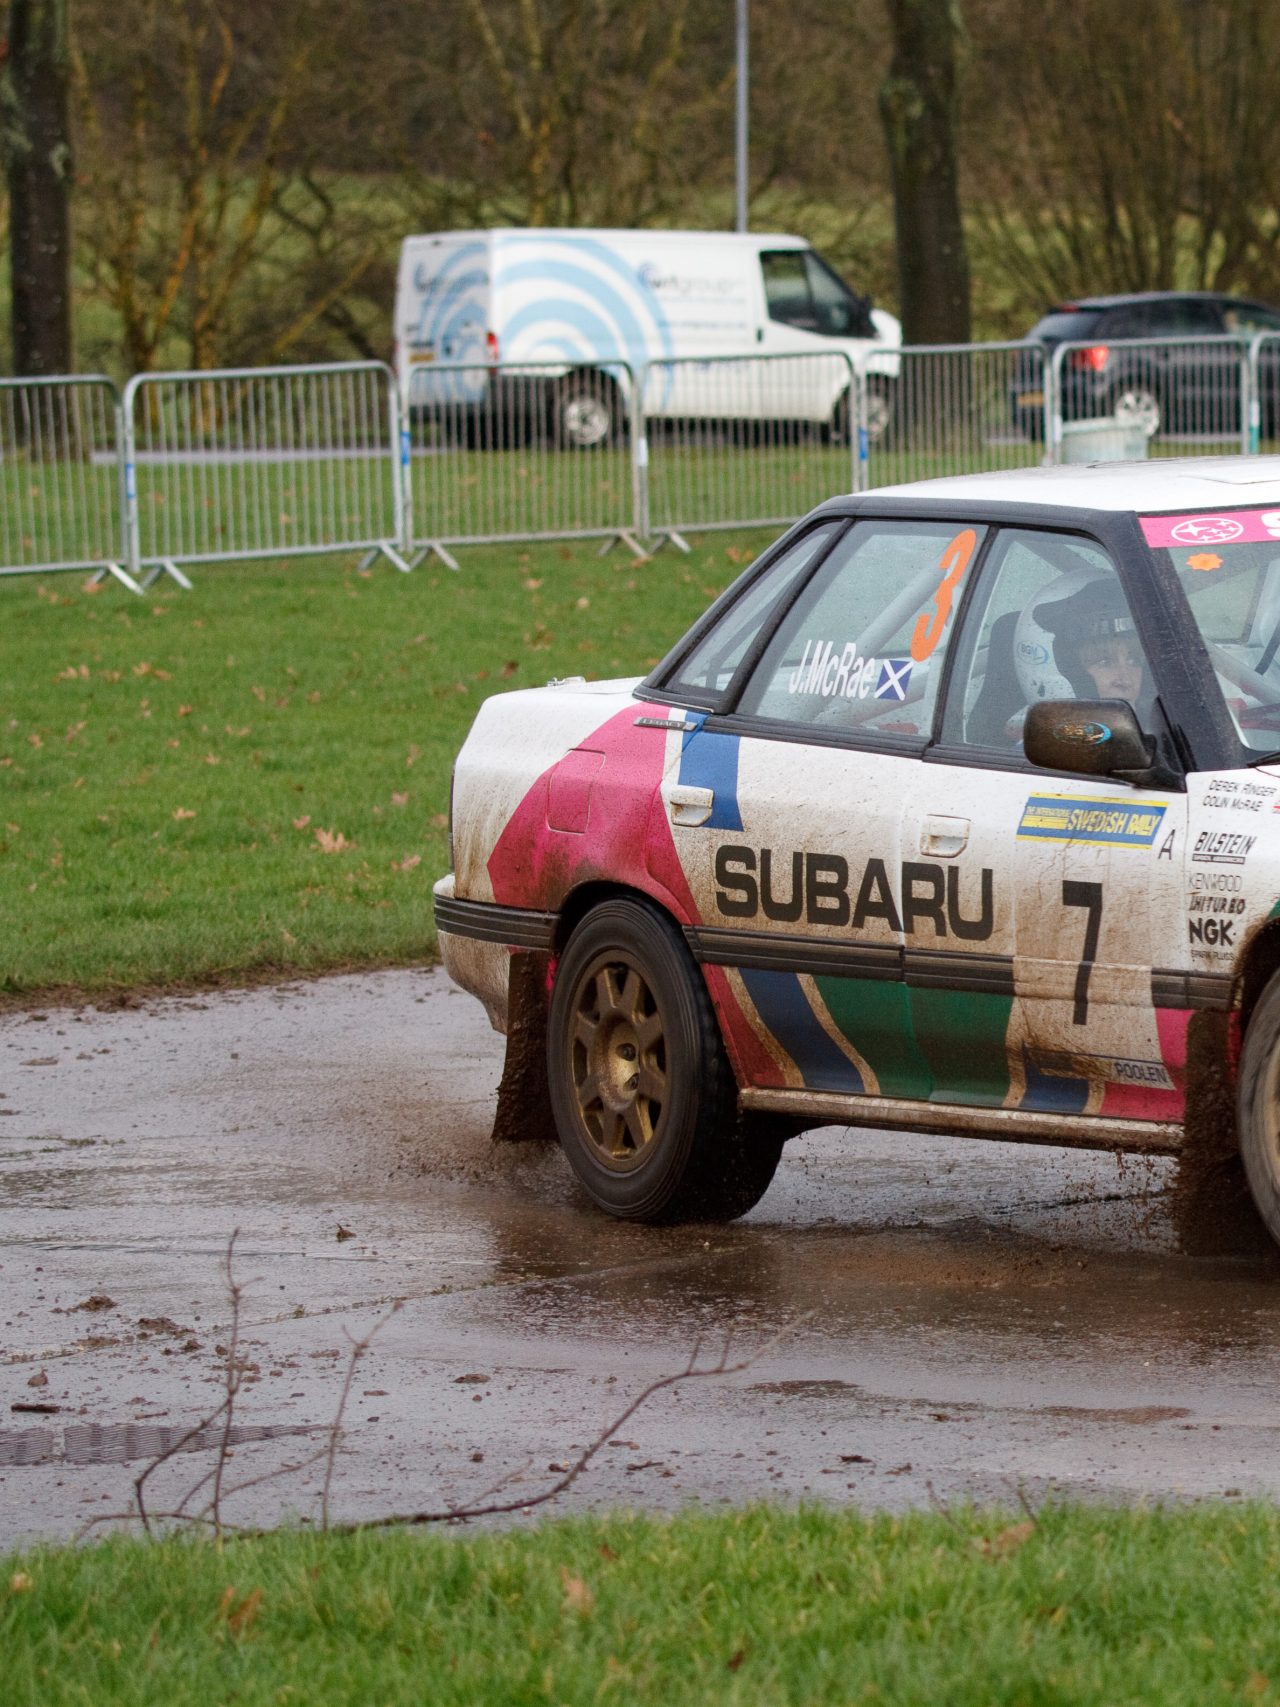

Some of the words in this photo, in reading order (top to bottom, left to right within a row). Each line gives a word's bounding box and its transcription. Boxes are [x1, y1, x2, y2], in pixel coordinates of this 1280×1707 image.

[910, 529, 976, 662] 3
[788, 640, 876, 699] J.McRae
[1202, 795, 1230, 808] COLIN
[1208, 779, 1240, 792] DEREK
[1157, 828, 1176, 860] A
[1194, 831, 1258, 855] BILSTEIN
[715, 845, 994, 941] SUBARU
[1063, 881, 1102, 1024] 7
